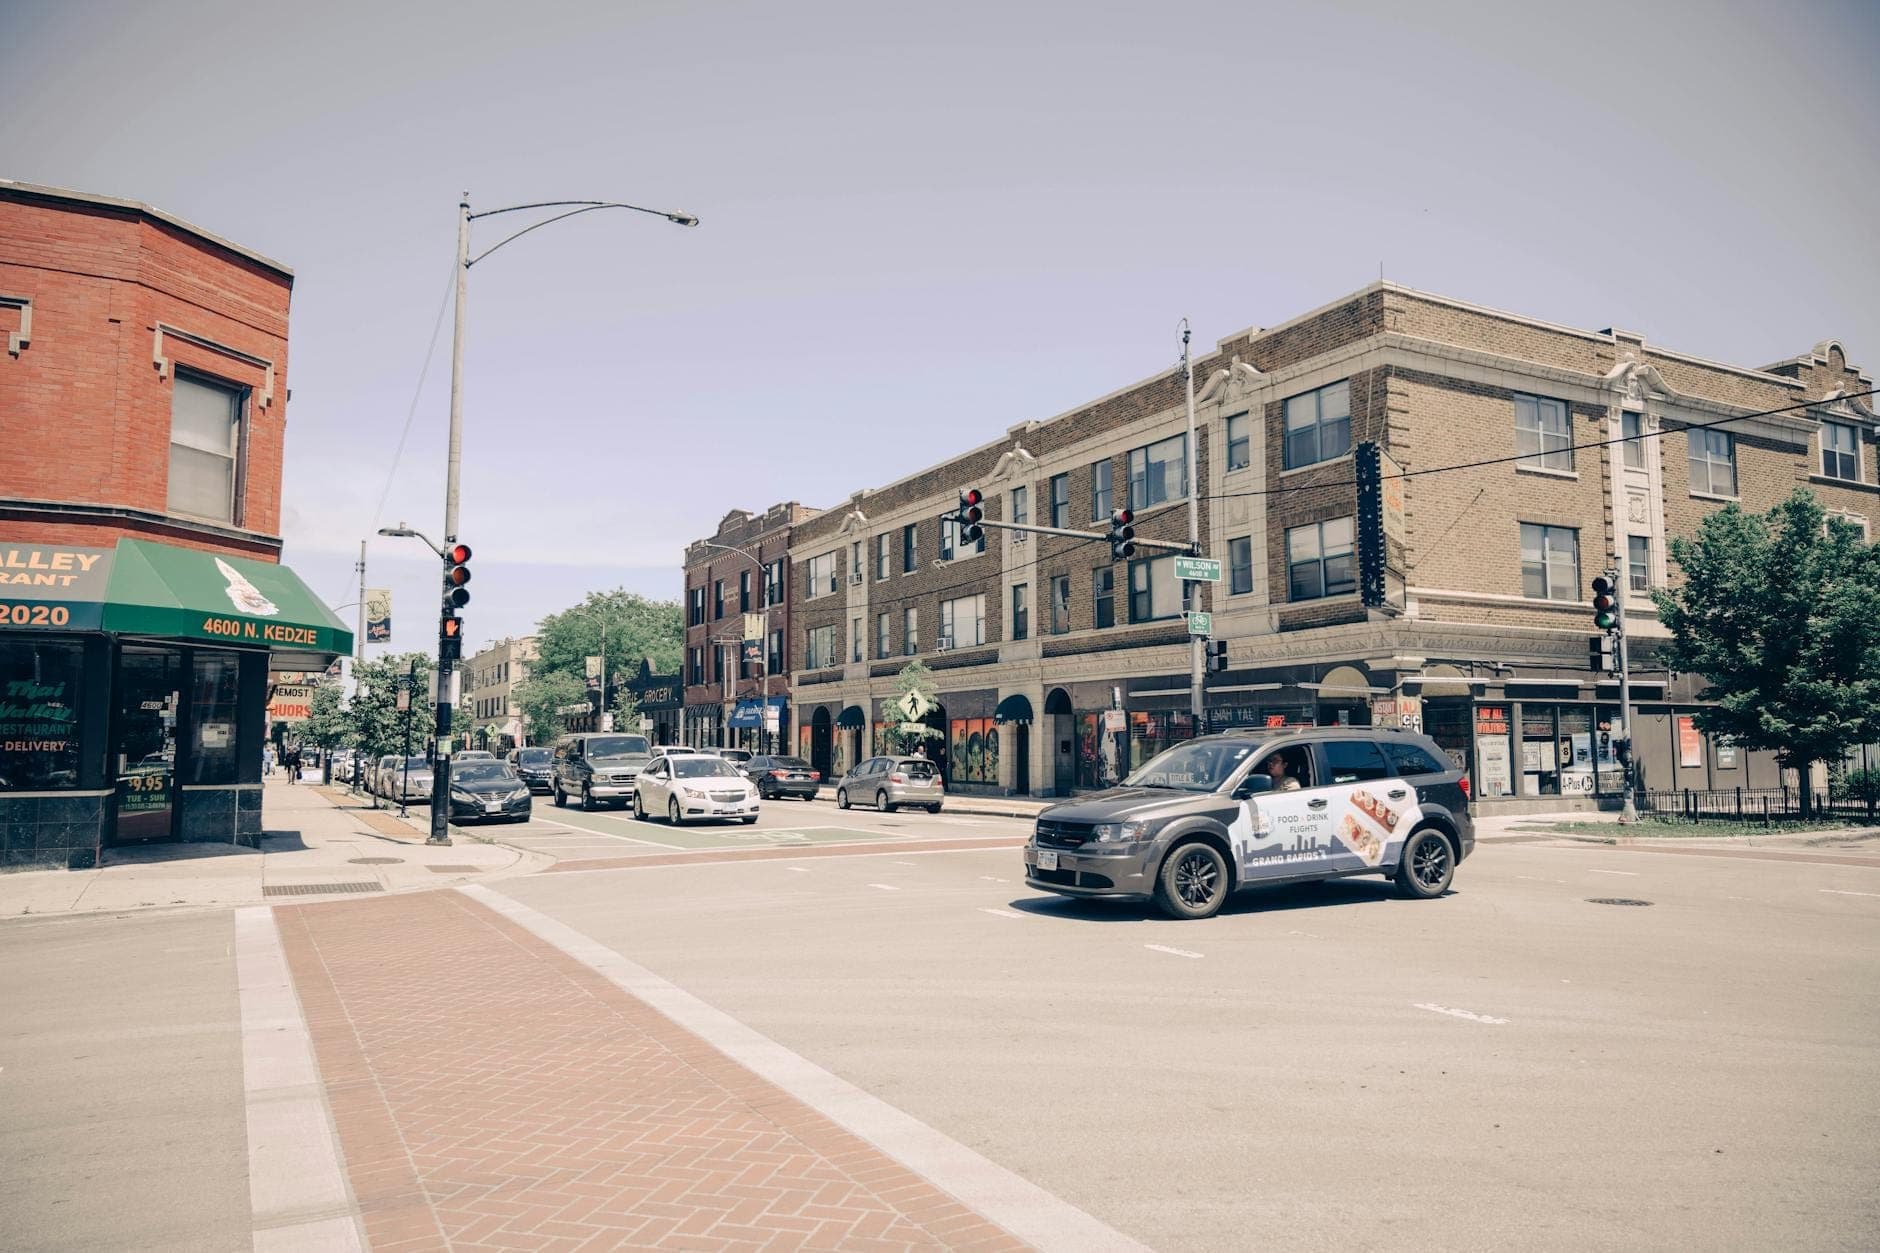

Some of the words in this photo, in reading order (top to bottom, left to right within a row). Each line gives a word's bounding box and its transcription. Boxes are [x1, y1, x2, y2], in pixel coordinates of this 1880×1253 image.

[0, 550, 101, 571] LLEY
[1183, 561, 1211, 571] WILSON
[0, 605, 69, 626] 2020
[203, 618, 240, 636] 4600
[245, 623, 259, 638] N.
[264, 625, 317, 644] KEDZIE
[0, 724, 72, 735] ESTAURANT
[5, 741, 66, 752] DELIVERY
[1307, 813, 1328, 821] DRINK
[1253, 856, 1284, 866] GRAND
[1287, 852, 1317, 862] RAPIDS
